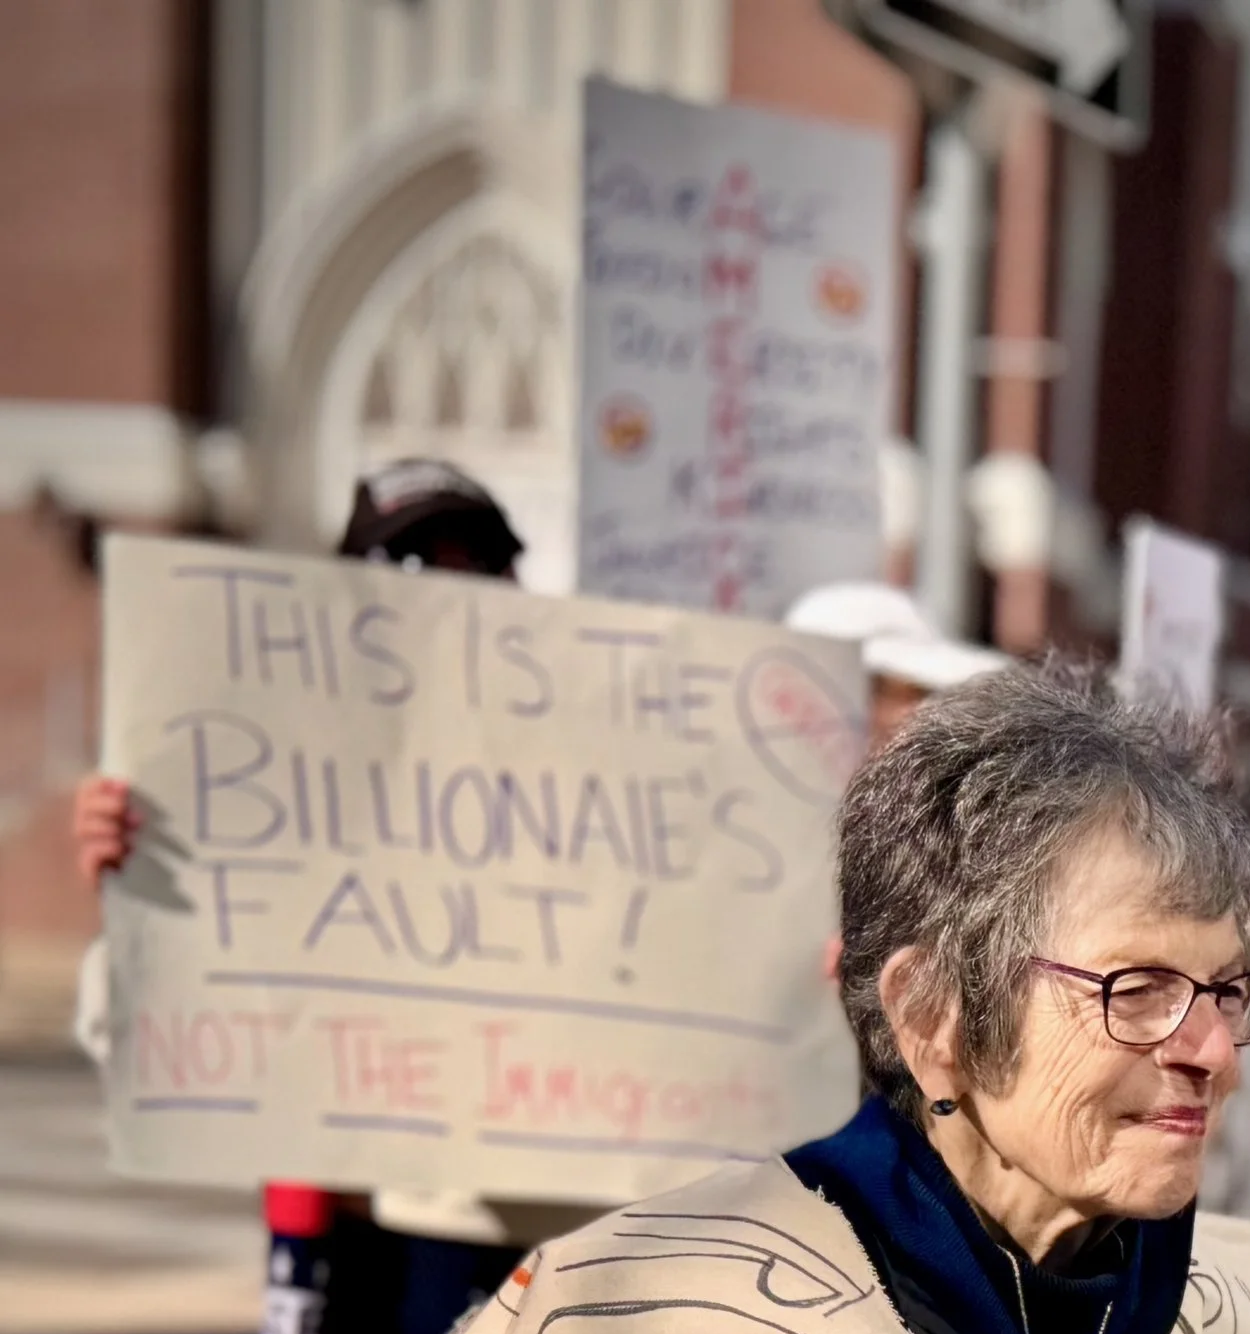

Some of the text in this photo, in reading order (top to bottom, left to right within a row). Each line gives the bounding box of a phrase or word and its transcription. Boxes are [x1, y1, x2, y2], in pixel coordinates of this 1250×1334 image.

[172, 564, 416, 708] THIS
[464, 600, 554, 717] IS
[576, 628, 732, 744] THE
[163, 708, 786, 893] BILLIONAIE'S
[134, 1007, 298, 1090] NOT
[313, 1014, 450, 1112] THE
